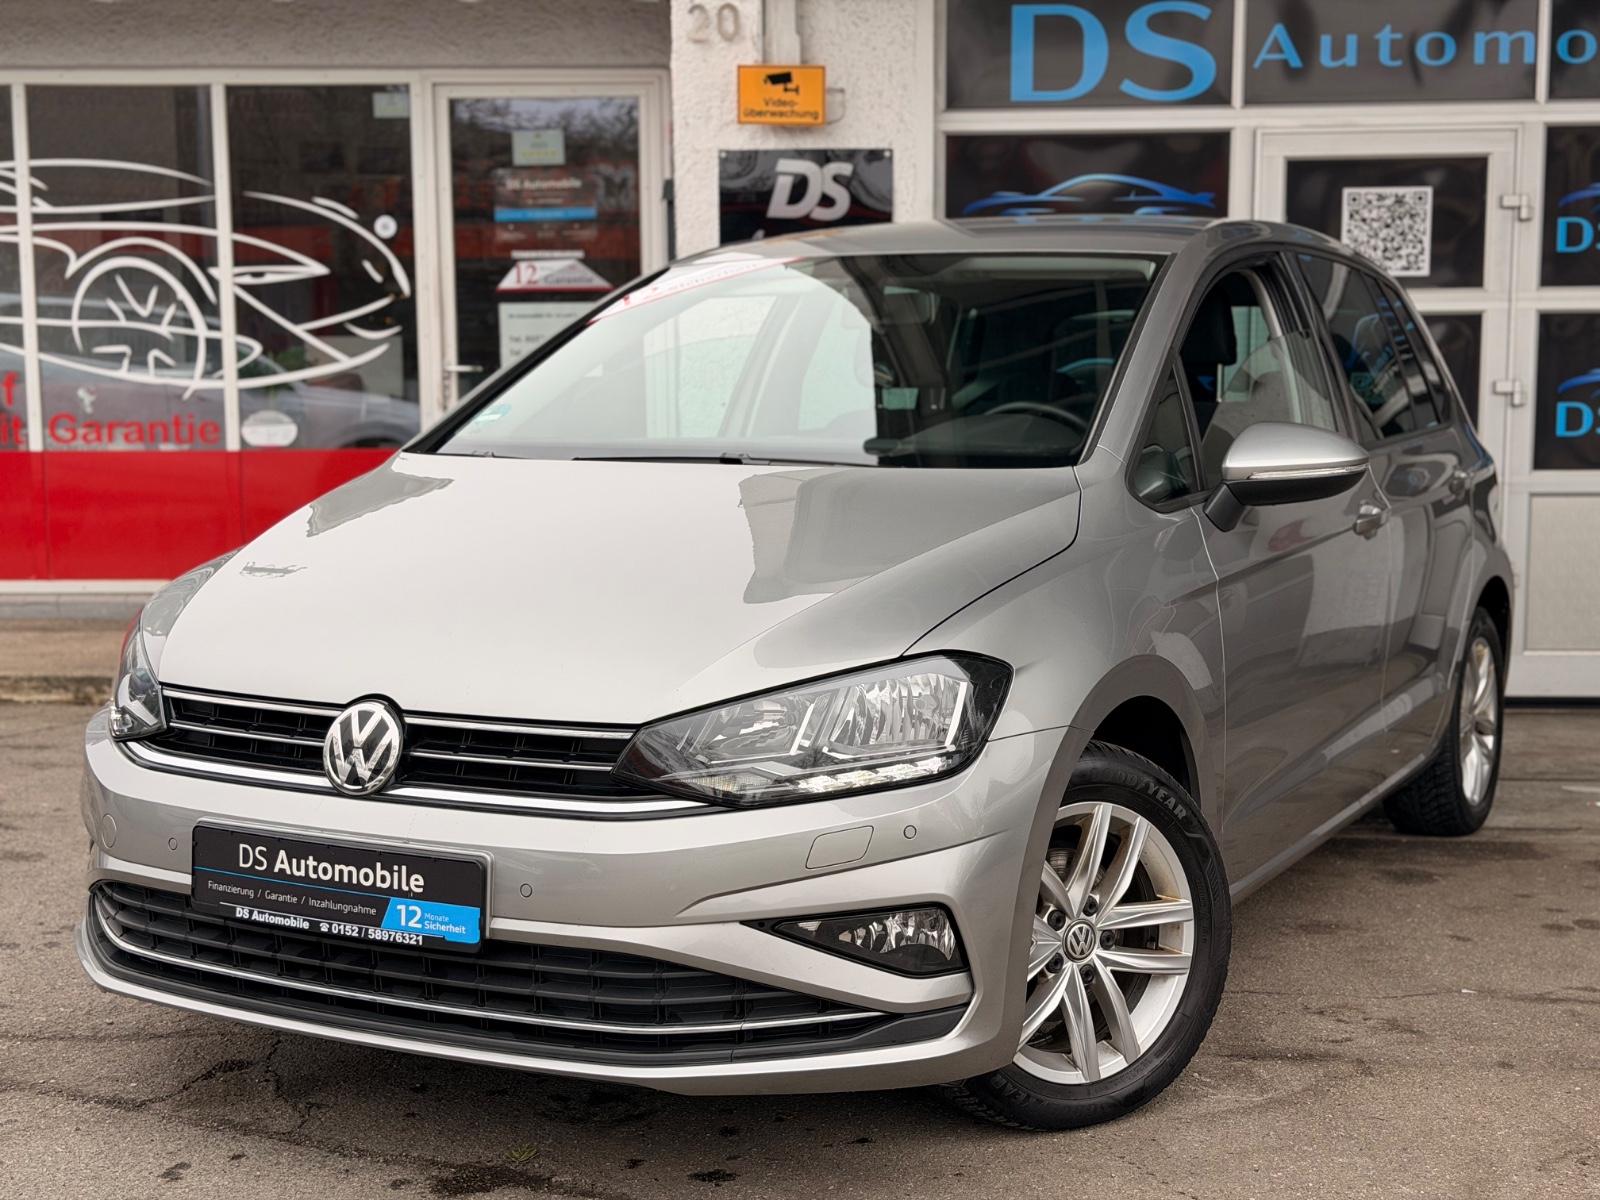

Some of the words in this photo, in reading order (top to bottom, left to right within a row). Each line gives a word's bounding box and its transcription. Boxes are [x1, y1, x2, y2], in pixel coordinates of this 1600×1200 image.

[687, 3, 741, 43] 20
[1010, 0, 1217, 102] DS
[1253, 23, 1598, 70] Automo
[766, 158, 854, 221] DS
[1556, 216, 1600, 253] D
[515, 262, 539, 285] 12
[48, 411, 221, 445] Garantie
[1555, 400, 1600, 438] D
[239, 843, 268, 871] DS
[273, 850, 425, 893] Automobile
[207, 880, 254, 899] Finanzierung
[265, 890, 298, 905] Garantie
[308, 897, 377, 917] Inzahlungnahme
[396, 904, 423, 929] 12
[424, 912, 450, 922] Monate
[235, 907, 250, 919] DS
[251, 910, 310, 930] Automobile
[331, 923, 359, 937] 0152
[367, 928, 423, 946] 58976321
[424, 920, 467, 935] Sicherheit
